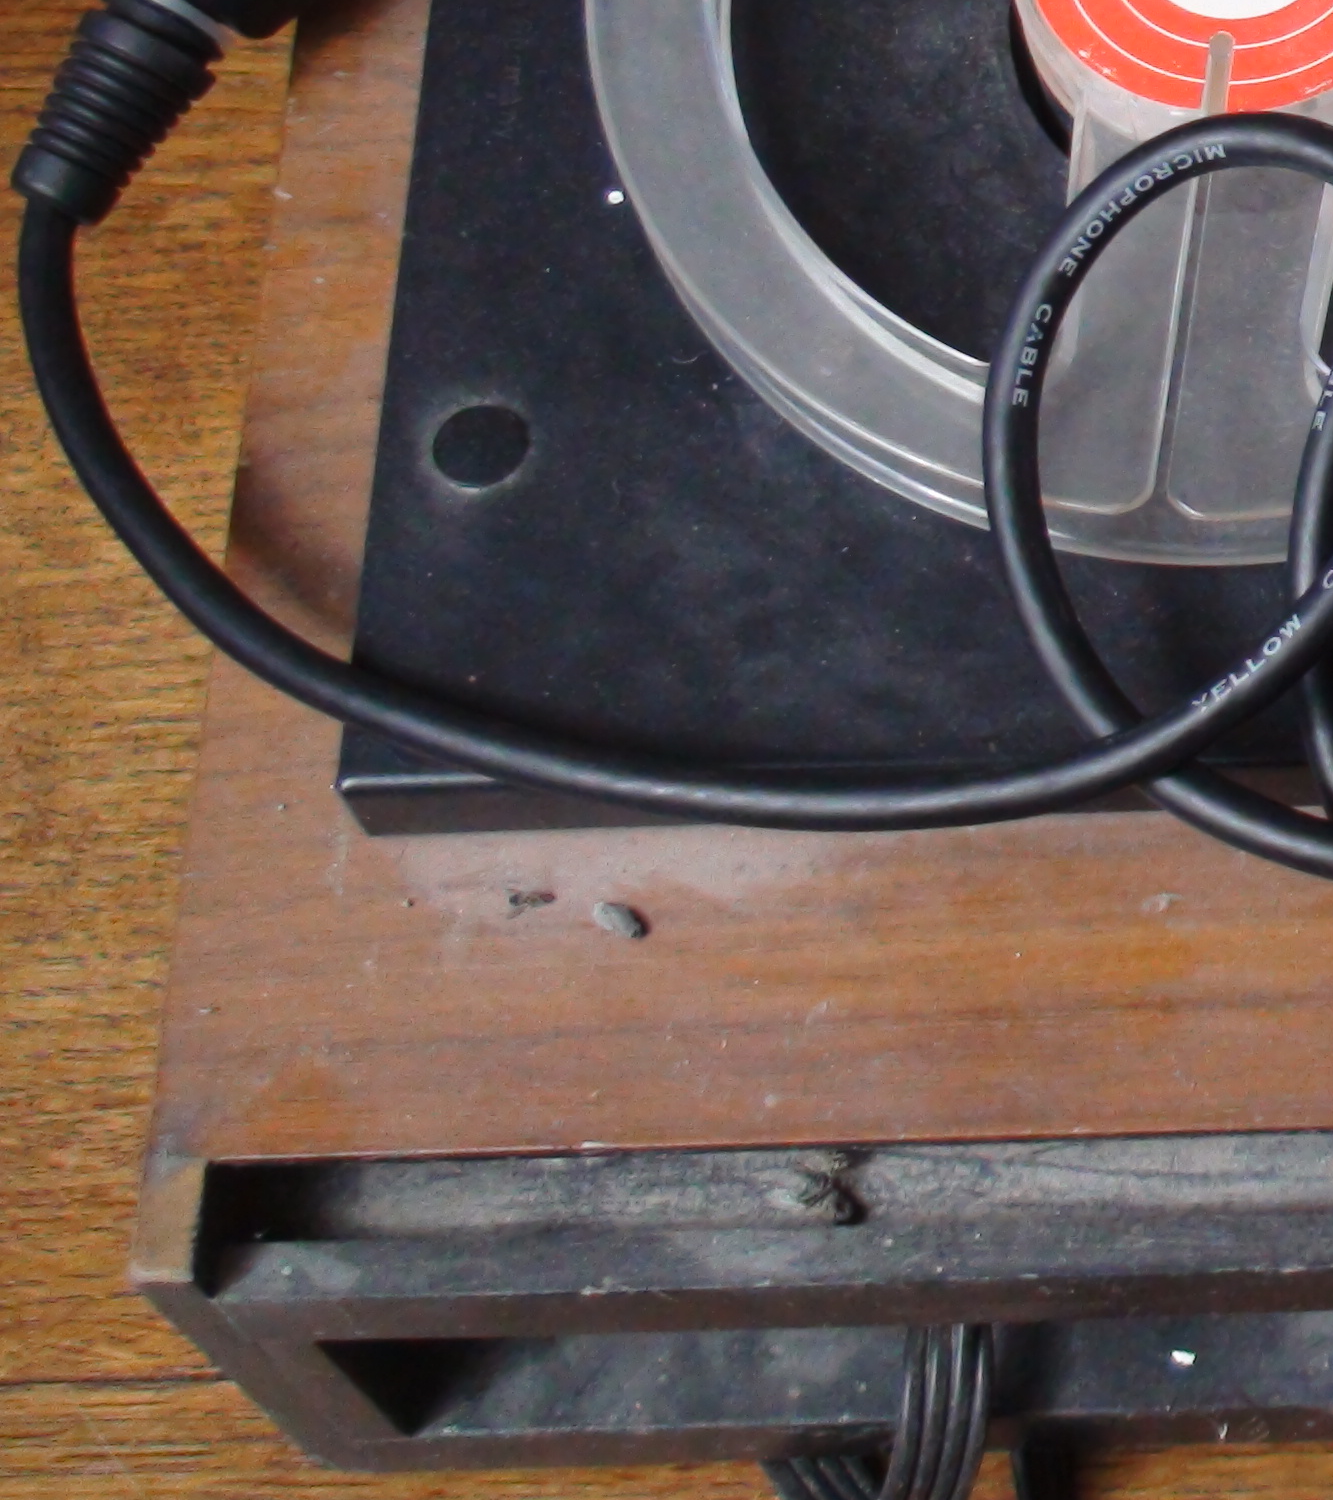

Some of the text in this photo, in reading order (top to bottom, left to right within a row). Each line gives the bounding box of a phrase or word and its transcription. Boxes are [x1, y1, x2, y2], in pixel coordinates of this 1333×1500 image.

[1010, 141, 1228, 409] MICROPHONE CABLE
[1190, 611, 1302, 711] YELLOW
